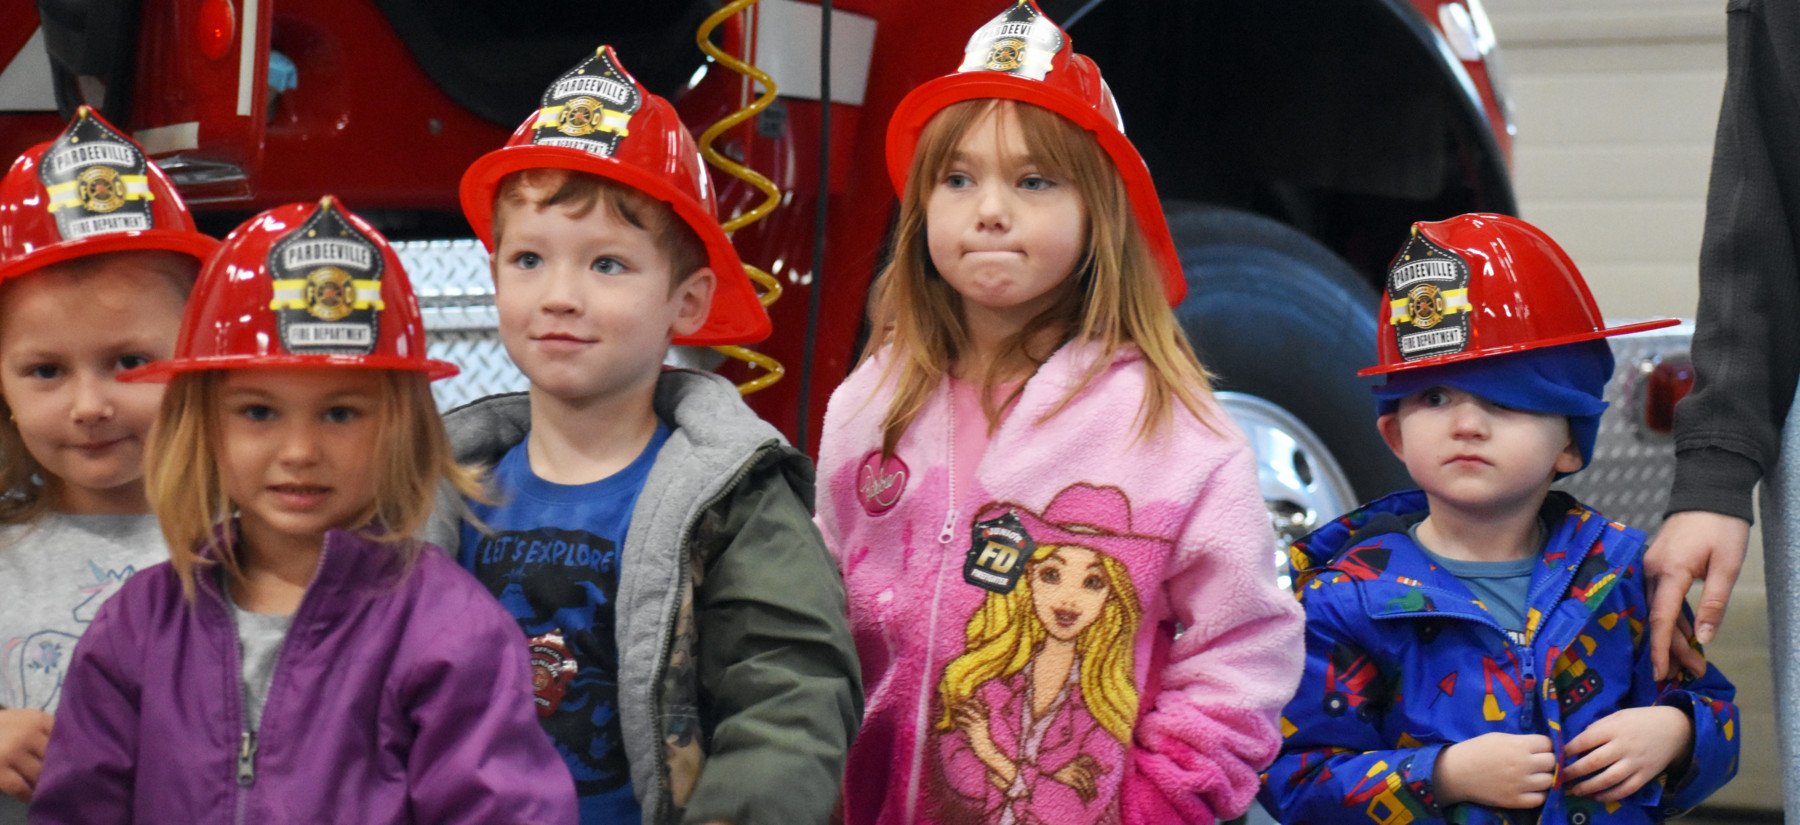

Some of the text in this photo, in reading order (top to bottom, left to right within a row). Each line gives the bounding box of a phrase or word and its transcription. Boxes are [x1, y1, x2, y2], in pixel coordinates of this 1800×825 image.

[557, 79, 625, 101] PARDEEVILLE
[56, 145, 131, 170] PARDEEVILLE
[72, 216, 144, 234] FIRE DEPARTMENT
[288, 243, 368, 265] PARDEEVILLE
[1396, 261, 1453, 285] PARDEEVILLE
[292, 327, 368, 341] FIRE DEPARTMENT
[1402, 330, 1459, 349] FIRE DEPARTMENT
[482, 536, 615, 573] LET'S EXPLORE
[976, 541, 1019, 574] FD
[531, 659, 558, 678] UNIOR
